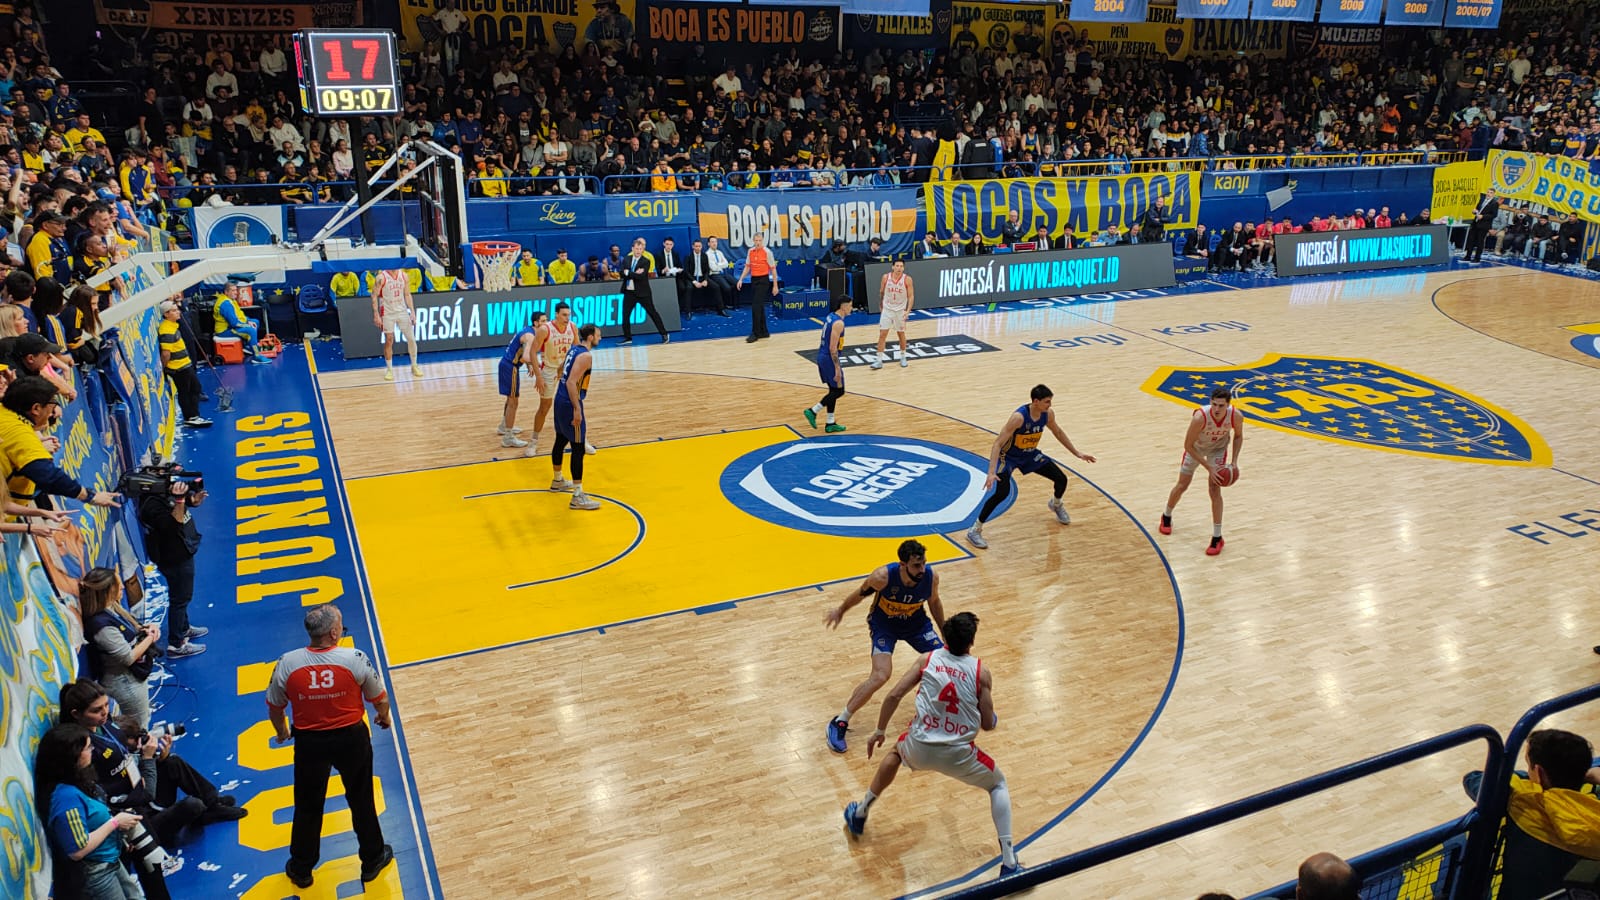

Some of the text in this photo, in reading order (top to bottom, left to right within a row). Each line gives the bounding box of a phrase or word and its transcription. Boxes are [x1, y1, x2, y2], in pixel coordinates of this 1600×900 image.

[174, 7, 297, 27] XENEIZES
[649, 7, 702, 42] BOCA
[707, 9, 731, 42] ES
[735, 10, 806, 43] PUEBLO
[1320, 27, 1383, 43] MUJERES
[323, 40, 380, 79] 17
[322, 89, 391, 111] 09:07
[1213, 175, 1250, 194] kanji
[540, 202, 576, 225] Leiva
[624, 199, 679, 222] kanji
[728, 201, 893, 247] BOCA ES PUEBLO
[933, 174, 1191, 242] LOCOS X BOCA
[1296, 234, 1433, 267] INGRESÁ A WWW.BASQUET.ID
[938, 257, 1120, 297] INGRESÁ A WWW.BASQUET.ID
[468, 304, 481, 338] A
[1152, 321, 1251, 336] kanji
[1020, 333, 1128, 351] kanji
[1231, 378, 1435, 421] CABJ
[790, 456, 899, 500] LOMA
[829, 460, 940, 509] NEGRA
[236, 411, 345, 607] JUNIORS
[308, 669, 335, 690] 13
[938, 681, 960, 715] 4
